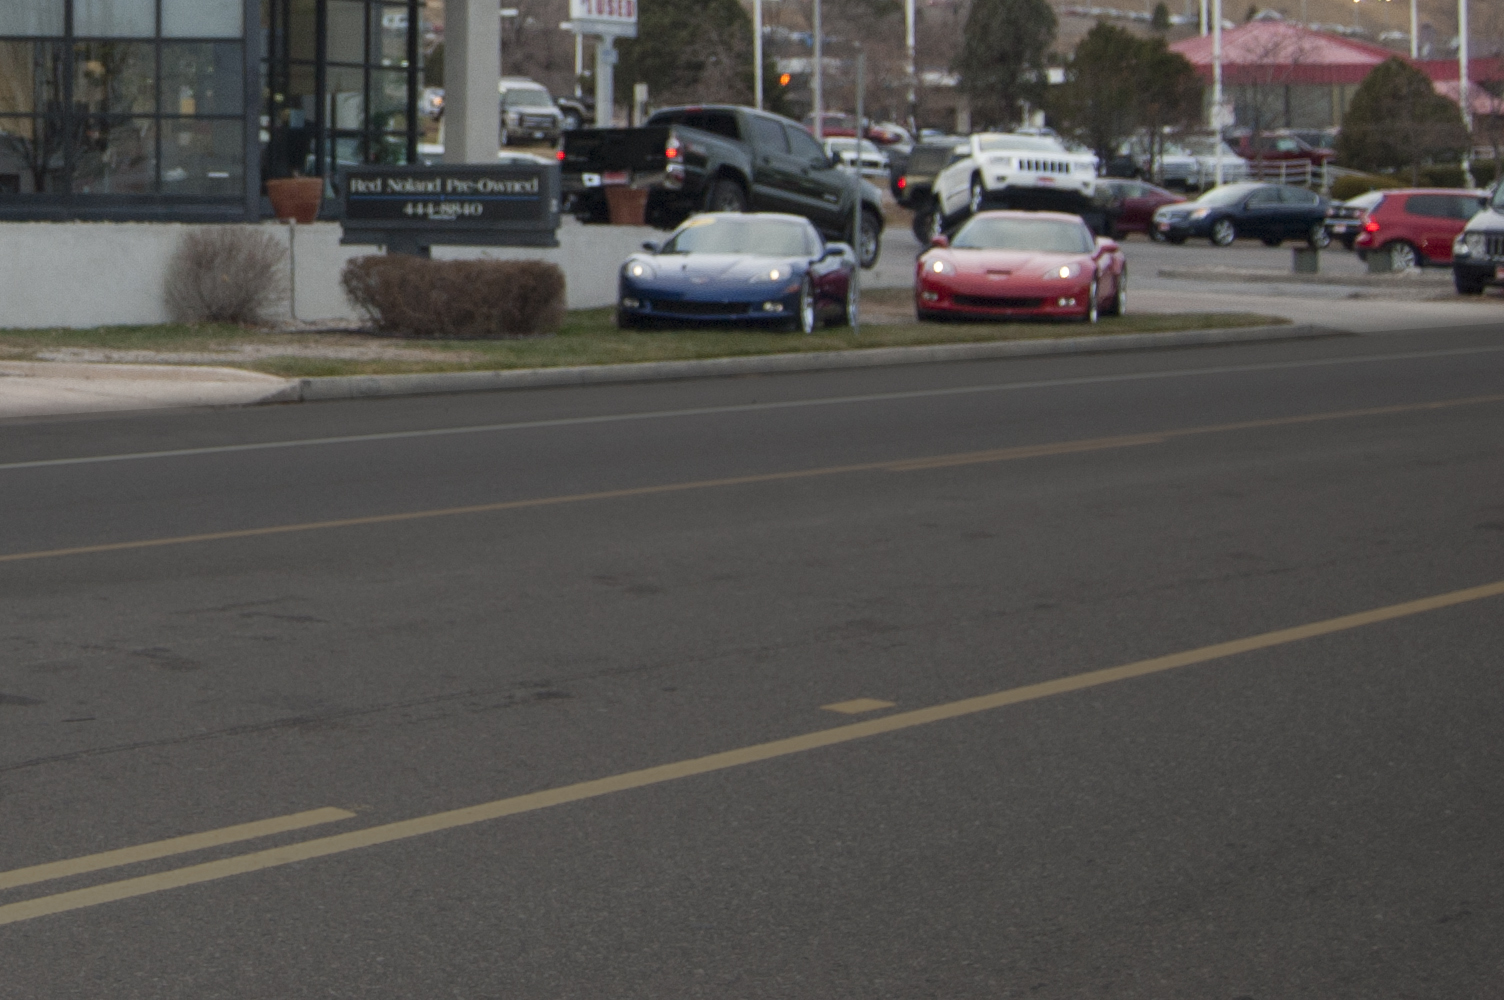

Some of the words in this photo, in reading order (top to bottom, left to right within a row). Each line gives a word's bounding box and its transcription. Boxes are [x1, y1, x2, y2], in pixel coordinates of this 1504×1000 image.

[350, 178, 382, 193] Red
[386, 177, 441, 194] Noland
[446, 177, 539, 194] Pre-Owned
